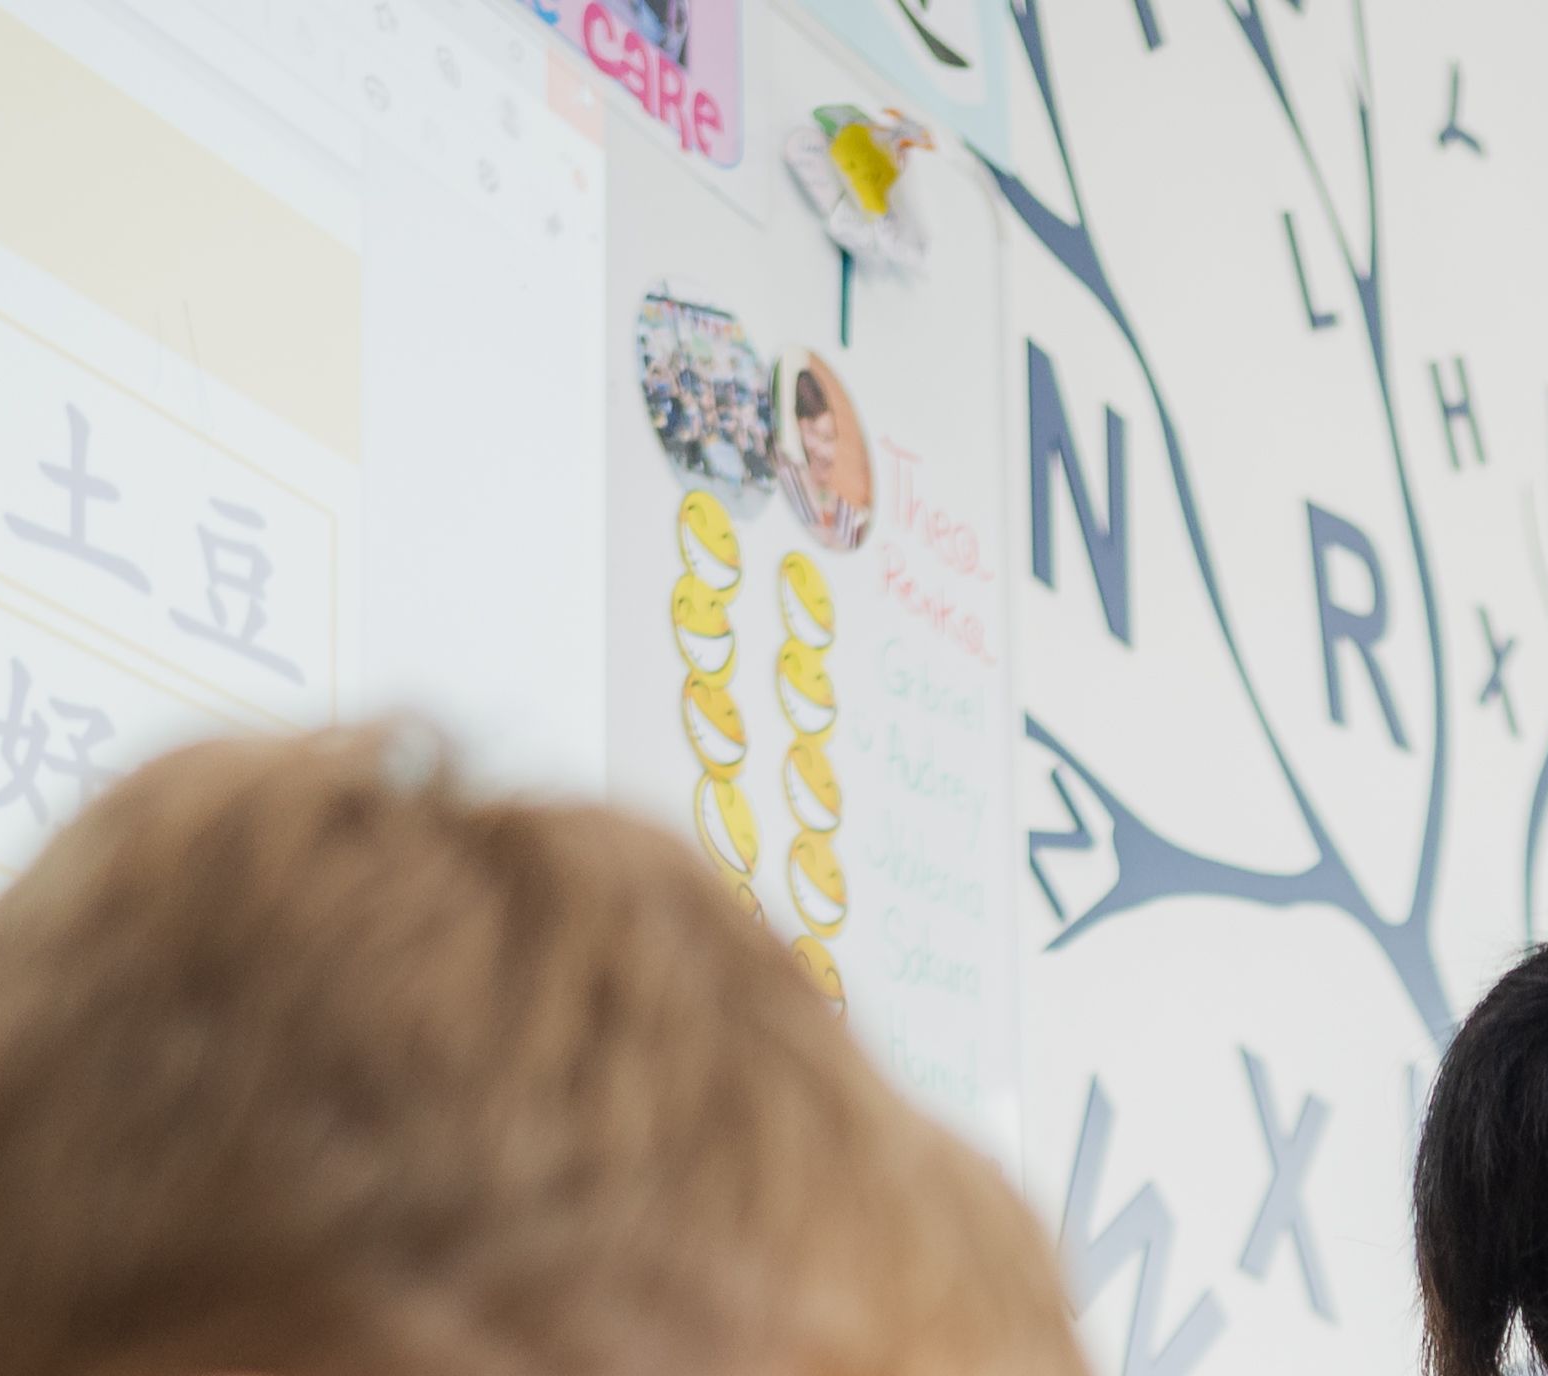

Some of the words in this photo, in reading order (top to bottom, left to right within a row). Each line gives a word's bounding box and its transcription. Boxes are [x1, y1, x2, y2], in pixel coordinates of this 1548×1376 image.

[2, 402, 307, 687] 土豆
[1027, 335, 1132, 650] N
[1304, 500, 1410, 752] R
